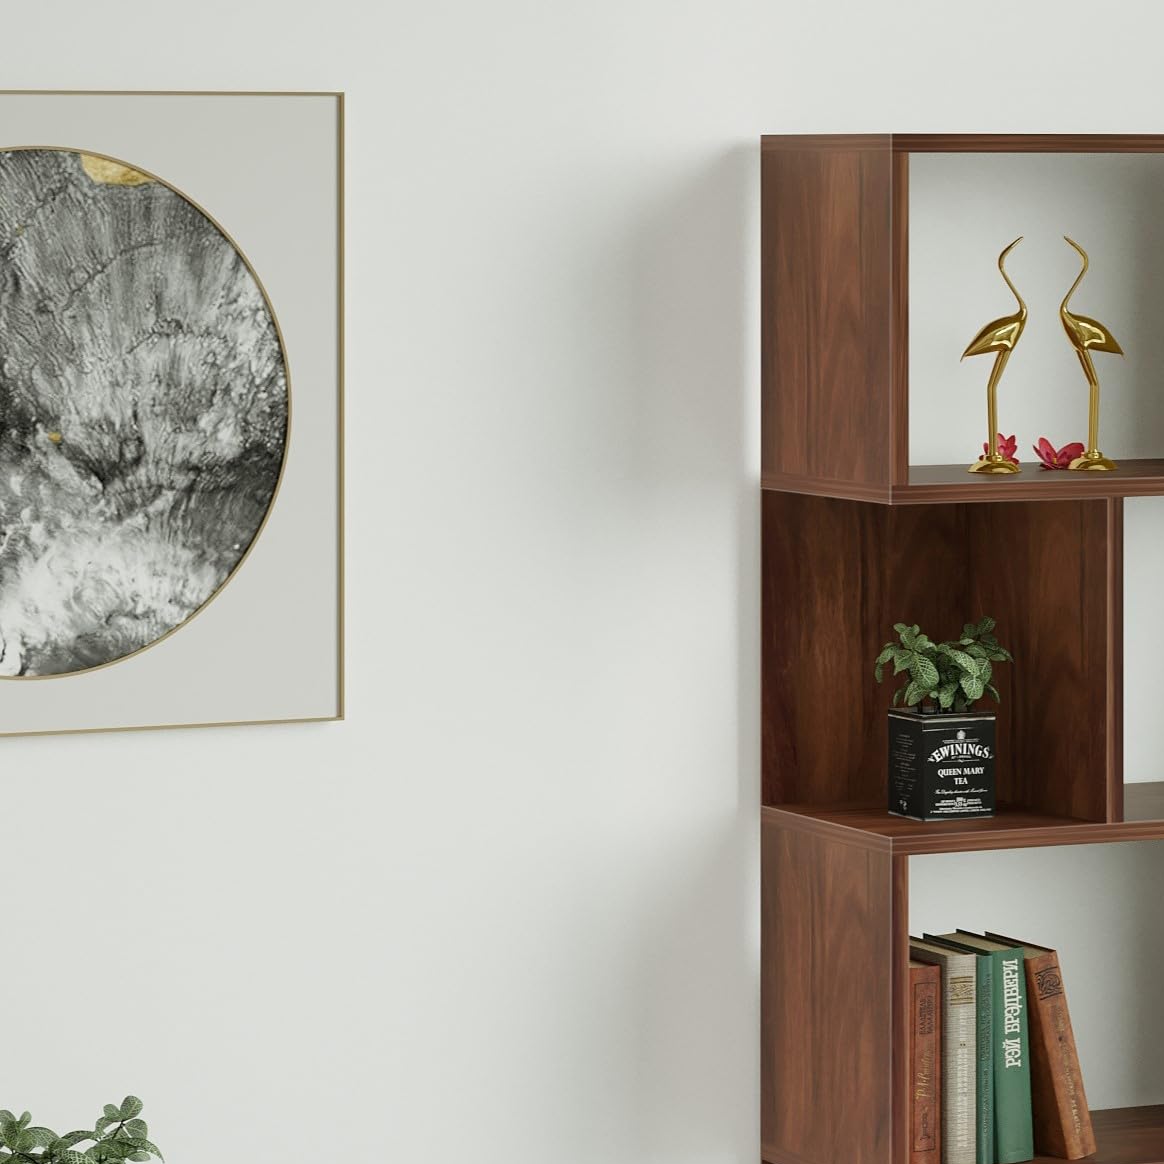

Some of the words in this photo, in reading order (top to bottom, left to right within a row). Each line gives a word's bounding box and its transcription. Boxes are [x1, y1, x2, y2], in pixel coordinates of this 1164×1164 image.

[937, 768, 961, 778] QUEEN
[963, 766, 985, 775] MARY
[953, 777, 968, 785] TEA
[1002, 1037, 1022, 1068] РЭЙ
